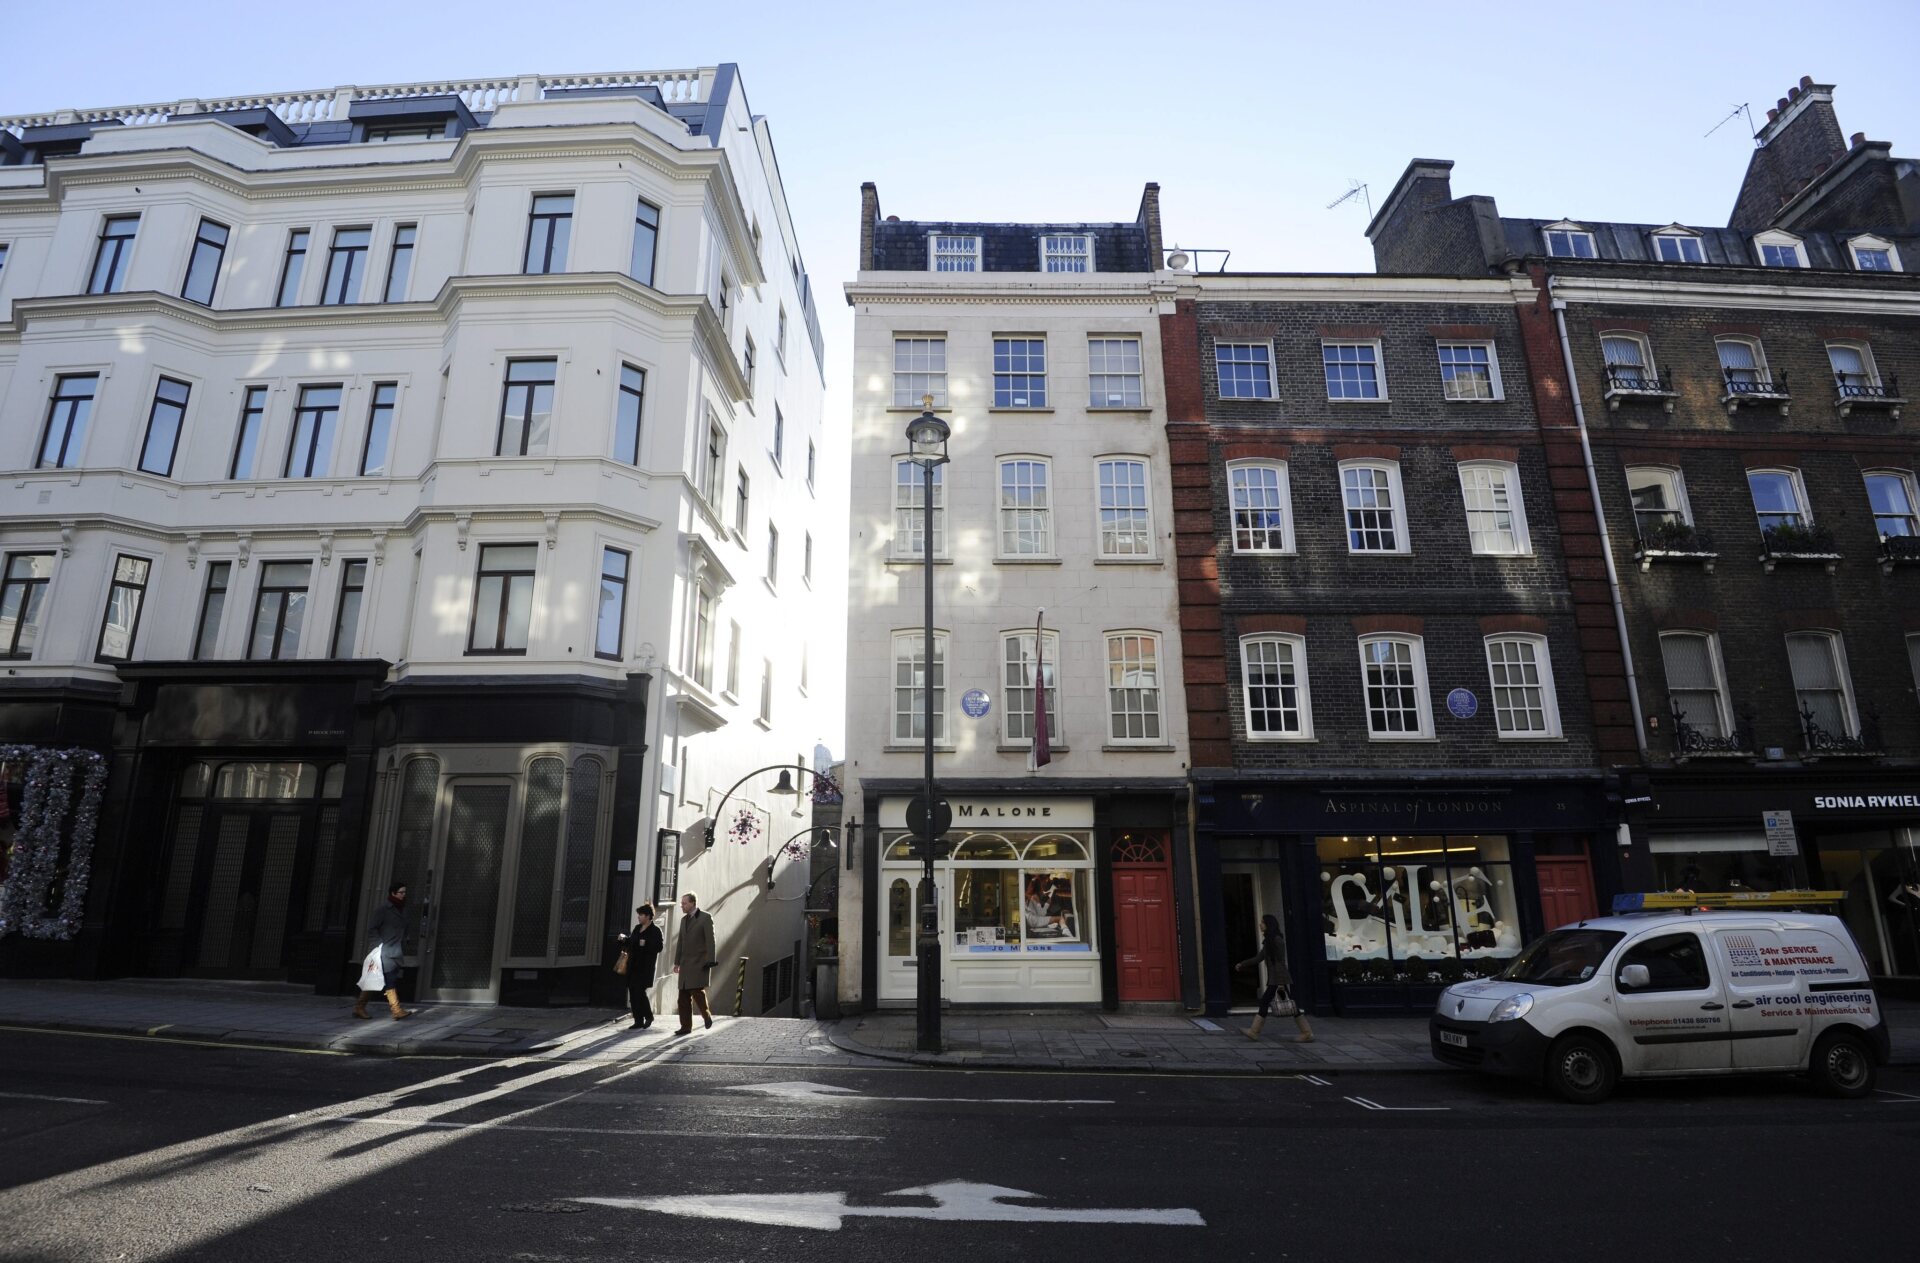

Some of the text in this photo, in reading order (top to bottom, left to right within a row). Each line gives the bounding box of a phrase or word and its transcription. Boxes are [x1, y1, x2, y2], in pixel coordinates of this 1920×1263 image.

[1815, 795, 1920, 808] SONIA RYKIEL
[958, 805, 1051, 817] MALONE
[1325, 798, 1502, 825] ASPINAL of LONDON
[1759, 946, 1818, 956] 24hr SERVICE
[1763, 958, 1771, 966] &
[1772, 956, 1835, 966] MAINTENANCE
[1740, 970, 1771, 978] Conditioning
[1755, 992, 1872, 1006] air cool engineering
[1761, 1006, 1871, 1017] Service & Maintenance Ltd
